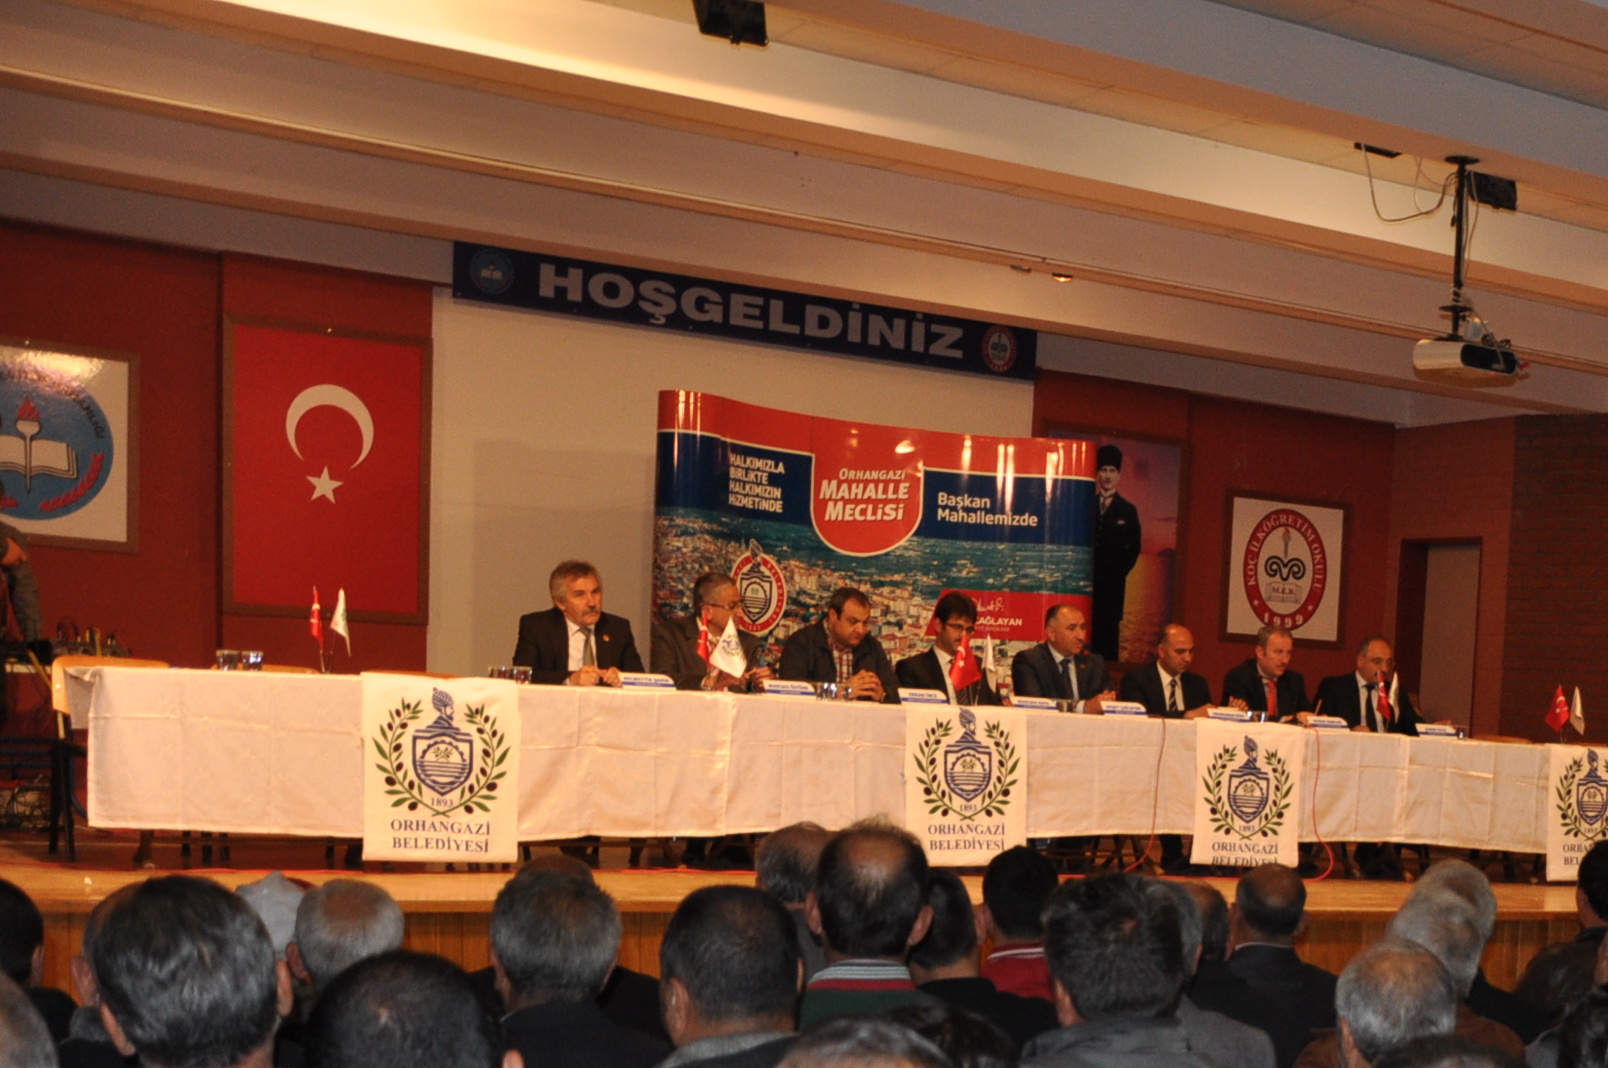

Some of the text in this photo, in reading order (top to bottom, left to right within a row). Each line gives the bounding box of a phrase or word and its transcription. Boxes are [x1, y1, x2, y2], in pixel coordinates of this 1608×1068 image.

[539, 263, 964, 359] HOŞGELDİNİZ
[730, 452, 785, 474] HALKIMIZLA
[729, 480, 781, 499] HALKIMIZIN
[819, 479, 910, 500] MAHALLE
[937, 491, 991, 510] Başkan
[937, 507, 1038, 527] Mahallemizde
[431, 797, 454, 807] 1893
[960, 804, 977, 812] 1893
[390, 819, 491, 835] ORHANGAZİ
[928, 823, 1006, 836] ORHANGAZİ
[392, 836, 489, 853] BELEDİYESİ
[929, 838, 1006, 851] BELEDİYESİ
[1212, 841, 1278, 854] ORHANGAZİ
